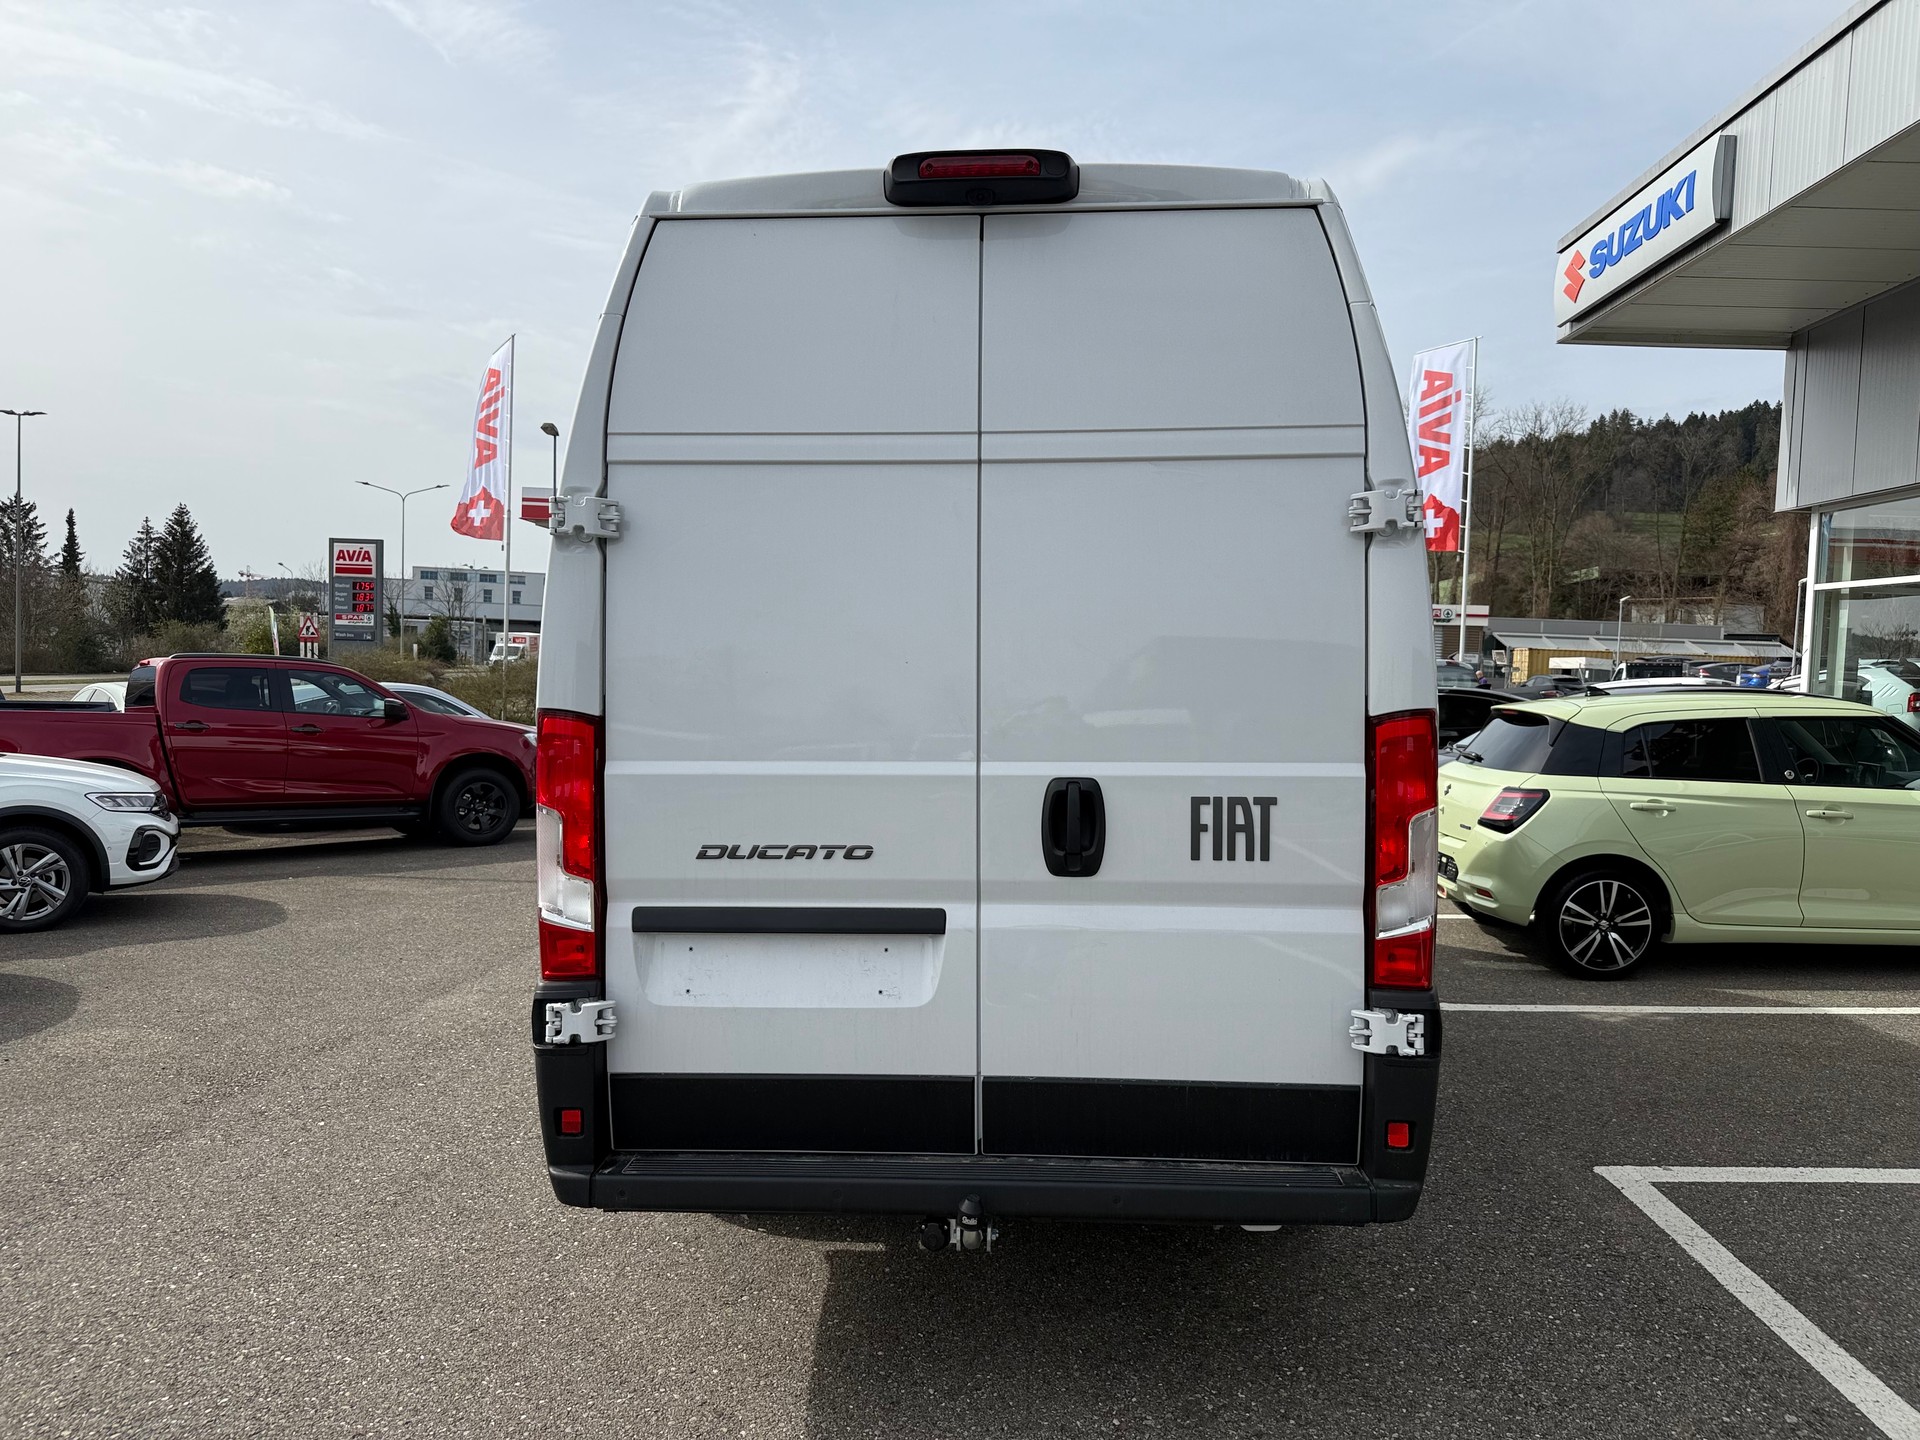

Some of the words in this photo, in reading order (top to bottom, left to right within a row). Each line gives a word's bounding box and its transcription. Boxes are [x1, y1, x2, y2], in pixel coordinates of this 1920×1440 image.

[1589, 170, 1697, 279] SUZUKI
[695, 844, 874, 860] DUCATO
[1190, 796, 1278, 862] FIAT
